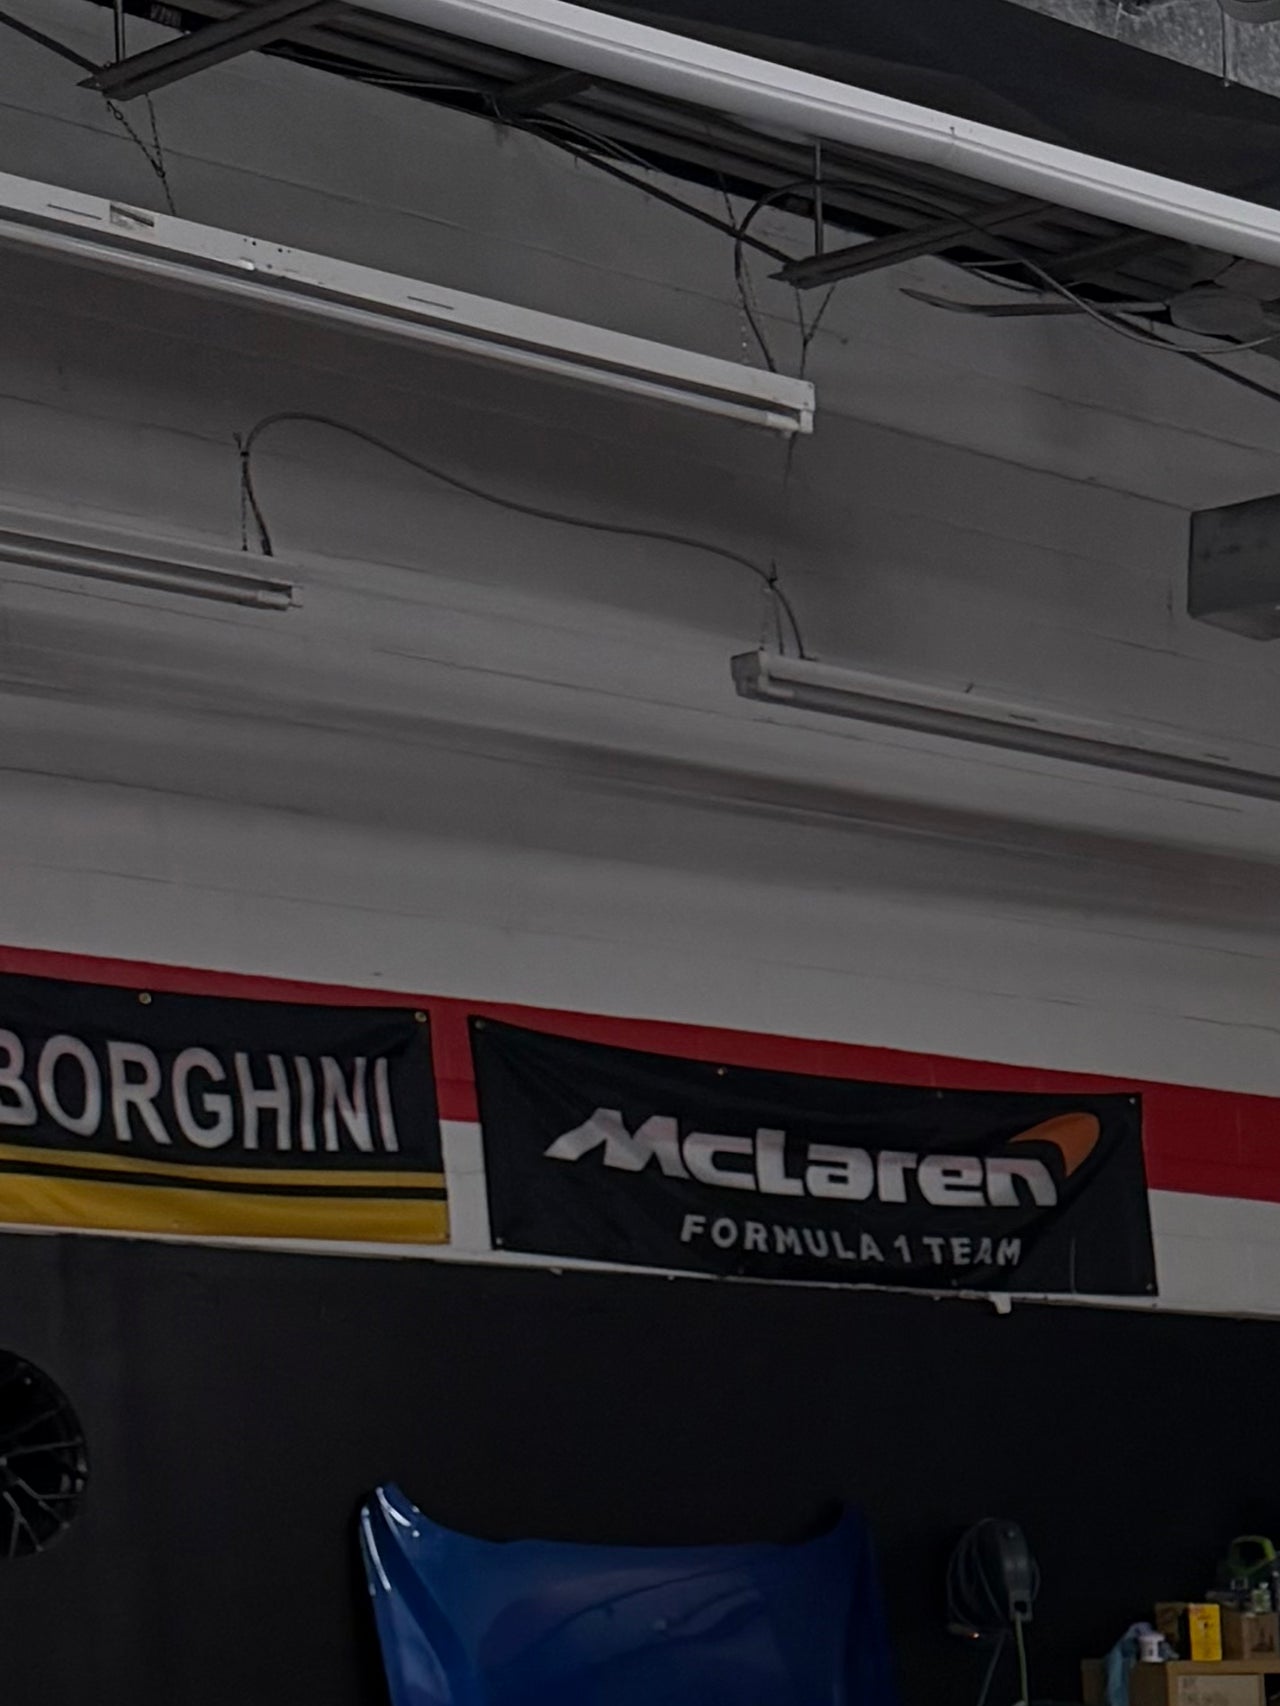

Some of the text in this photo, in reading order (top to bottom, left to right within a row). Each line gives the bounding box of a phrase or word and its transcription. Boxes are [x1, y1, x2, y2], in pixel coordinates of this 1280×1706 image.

[0, 1027, 400, 1153] BORGHINI
[542, 1106, 1059, 1208] McLaren
[679, 1212, 1022, 1267] FORMULA 1 TEAM
